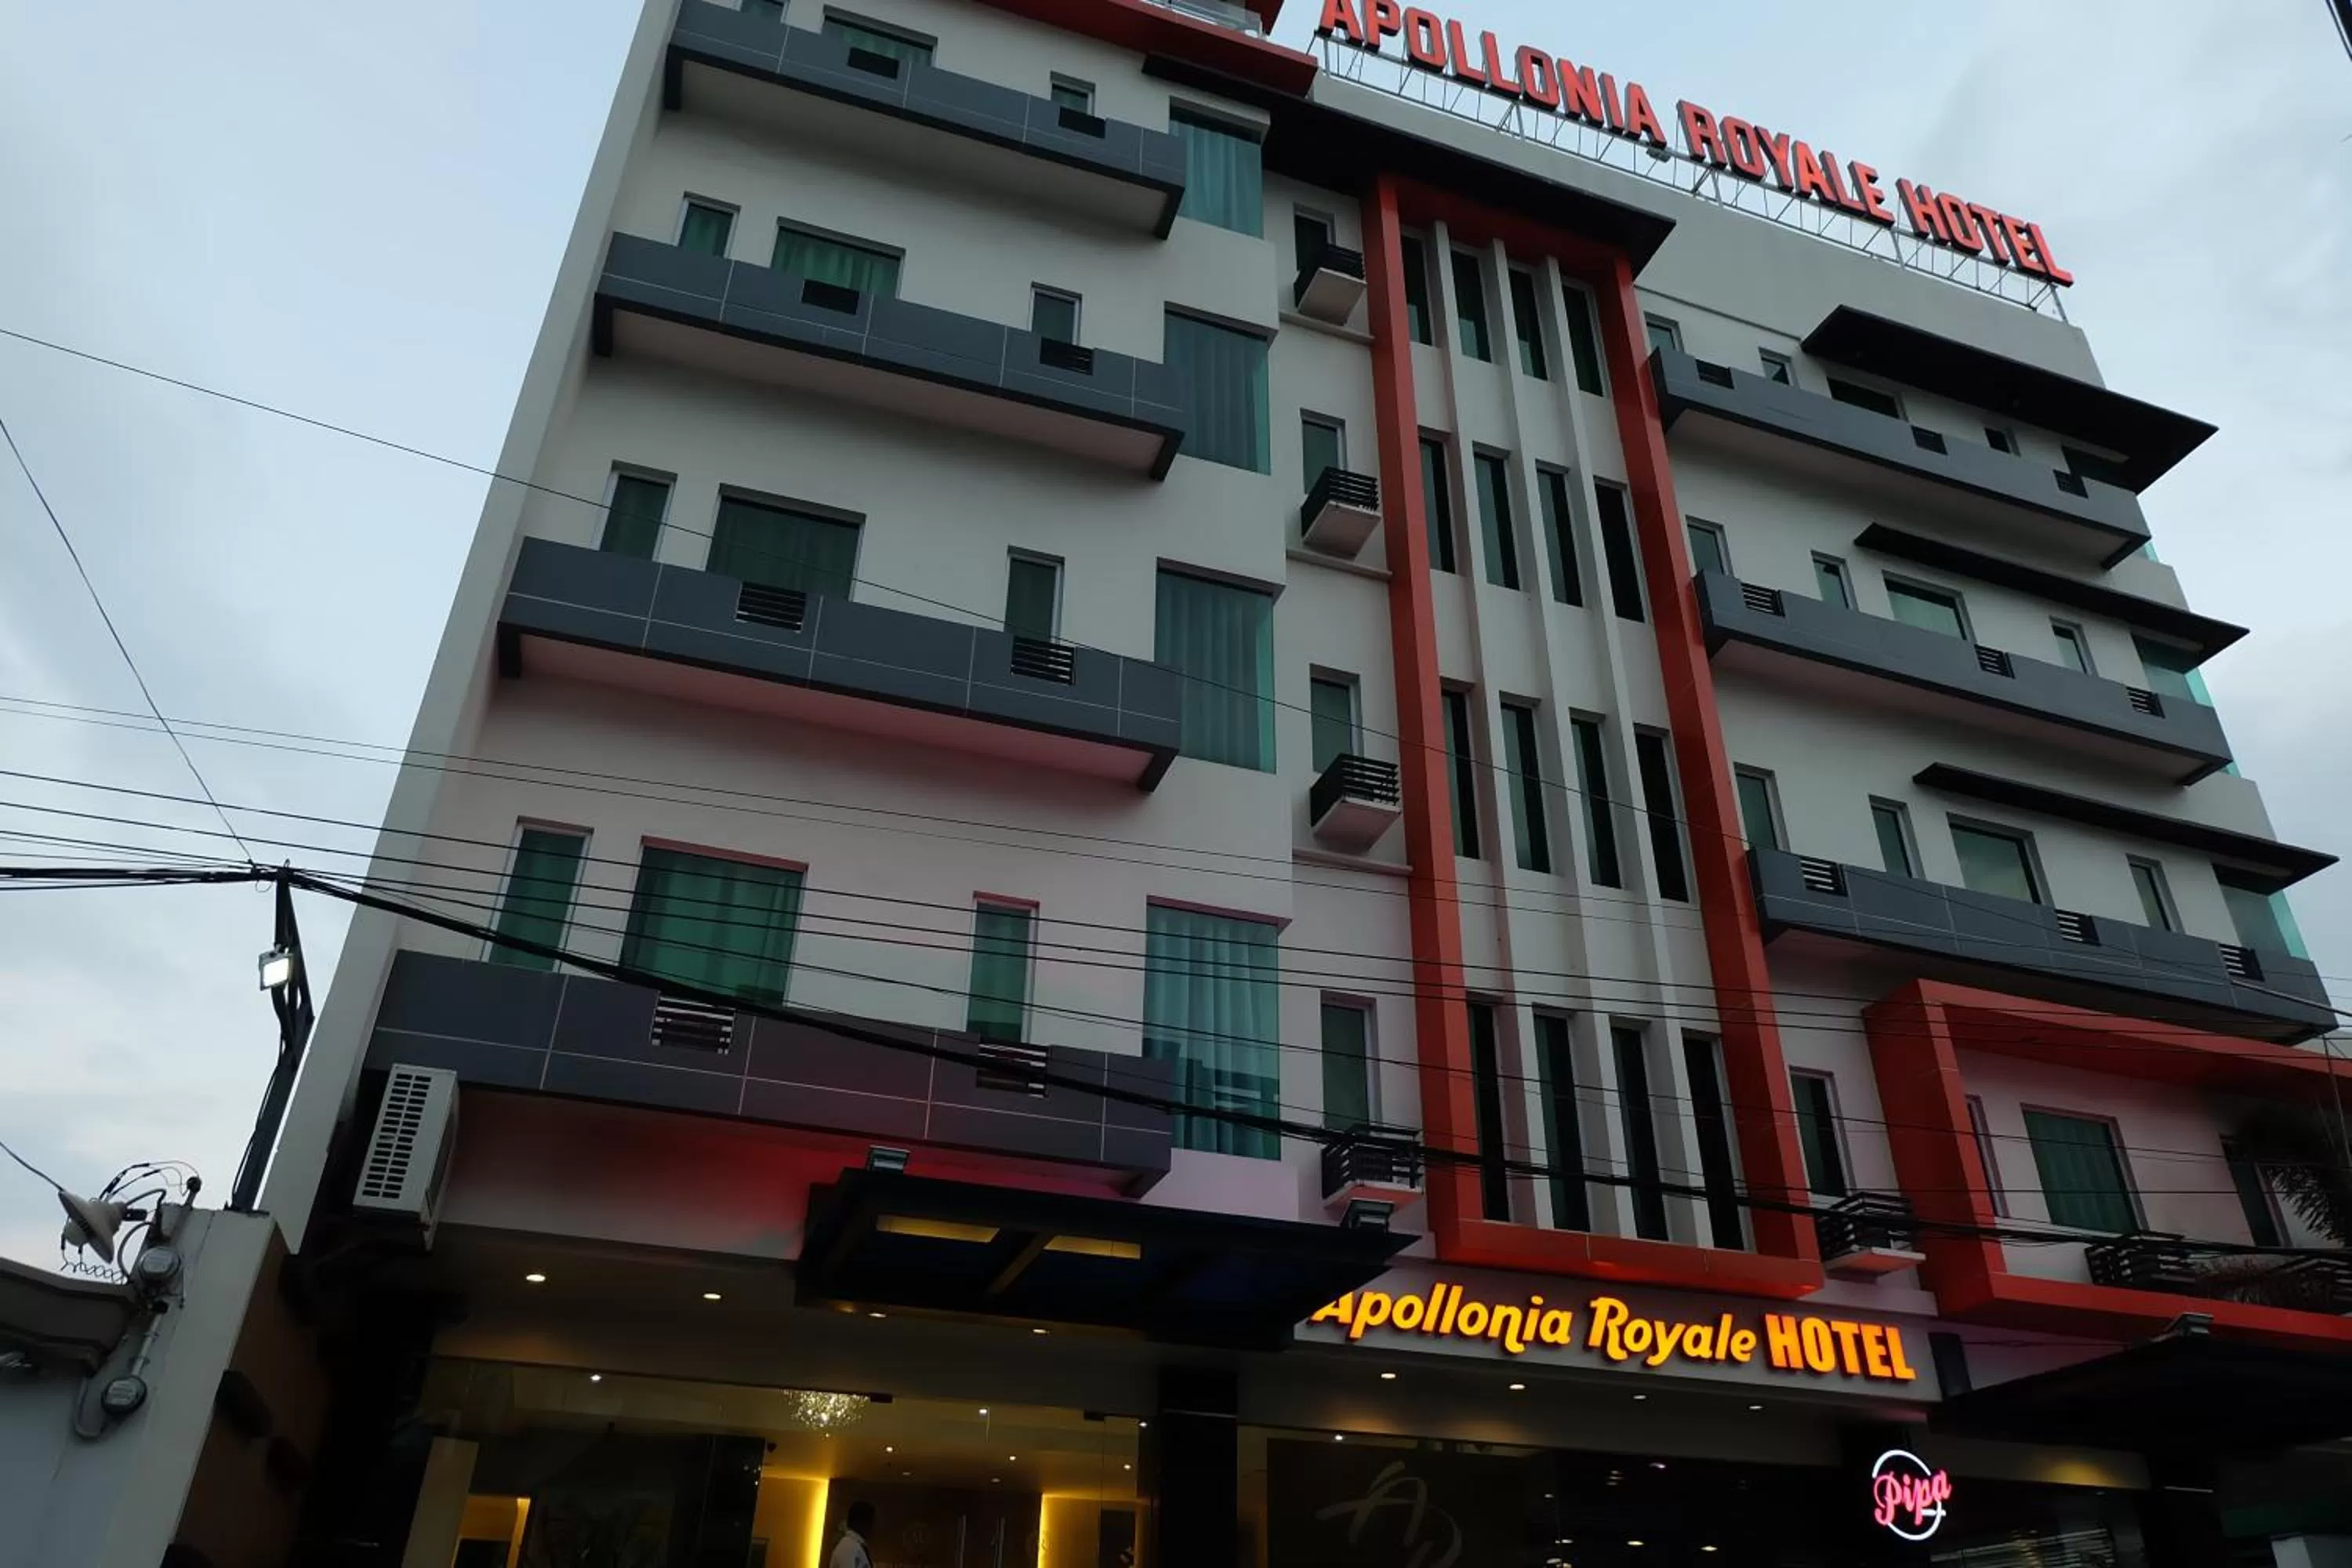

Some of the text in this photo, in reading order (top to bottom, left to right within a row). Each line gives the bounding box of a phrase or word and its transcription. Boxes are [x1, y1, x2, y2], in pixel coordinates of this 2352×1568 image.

[1314, 0, 2074, 288] APOLLONIA ROYALE HOTEL
[1310, 1281, 1918, 1381] Apollonia Royale HOTEL
[1873, 1468, 1953, 1526] Pipa
